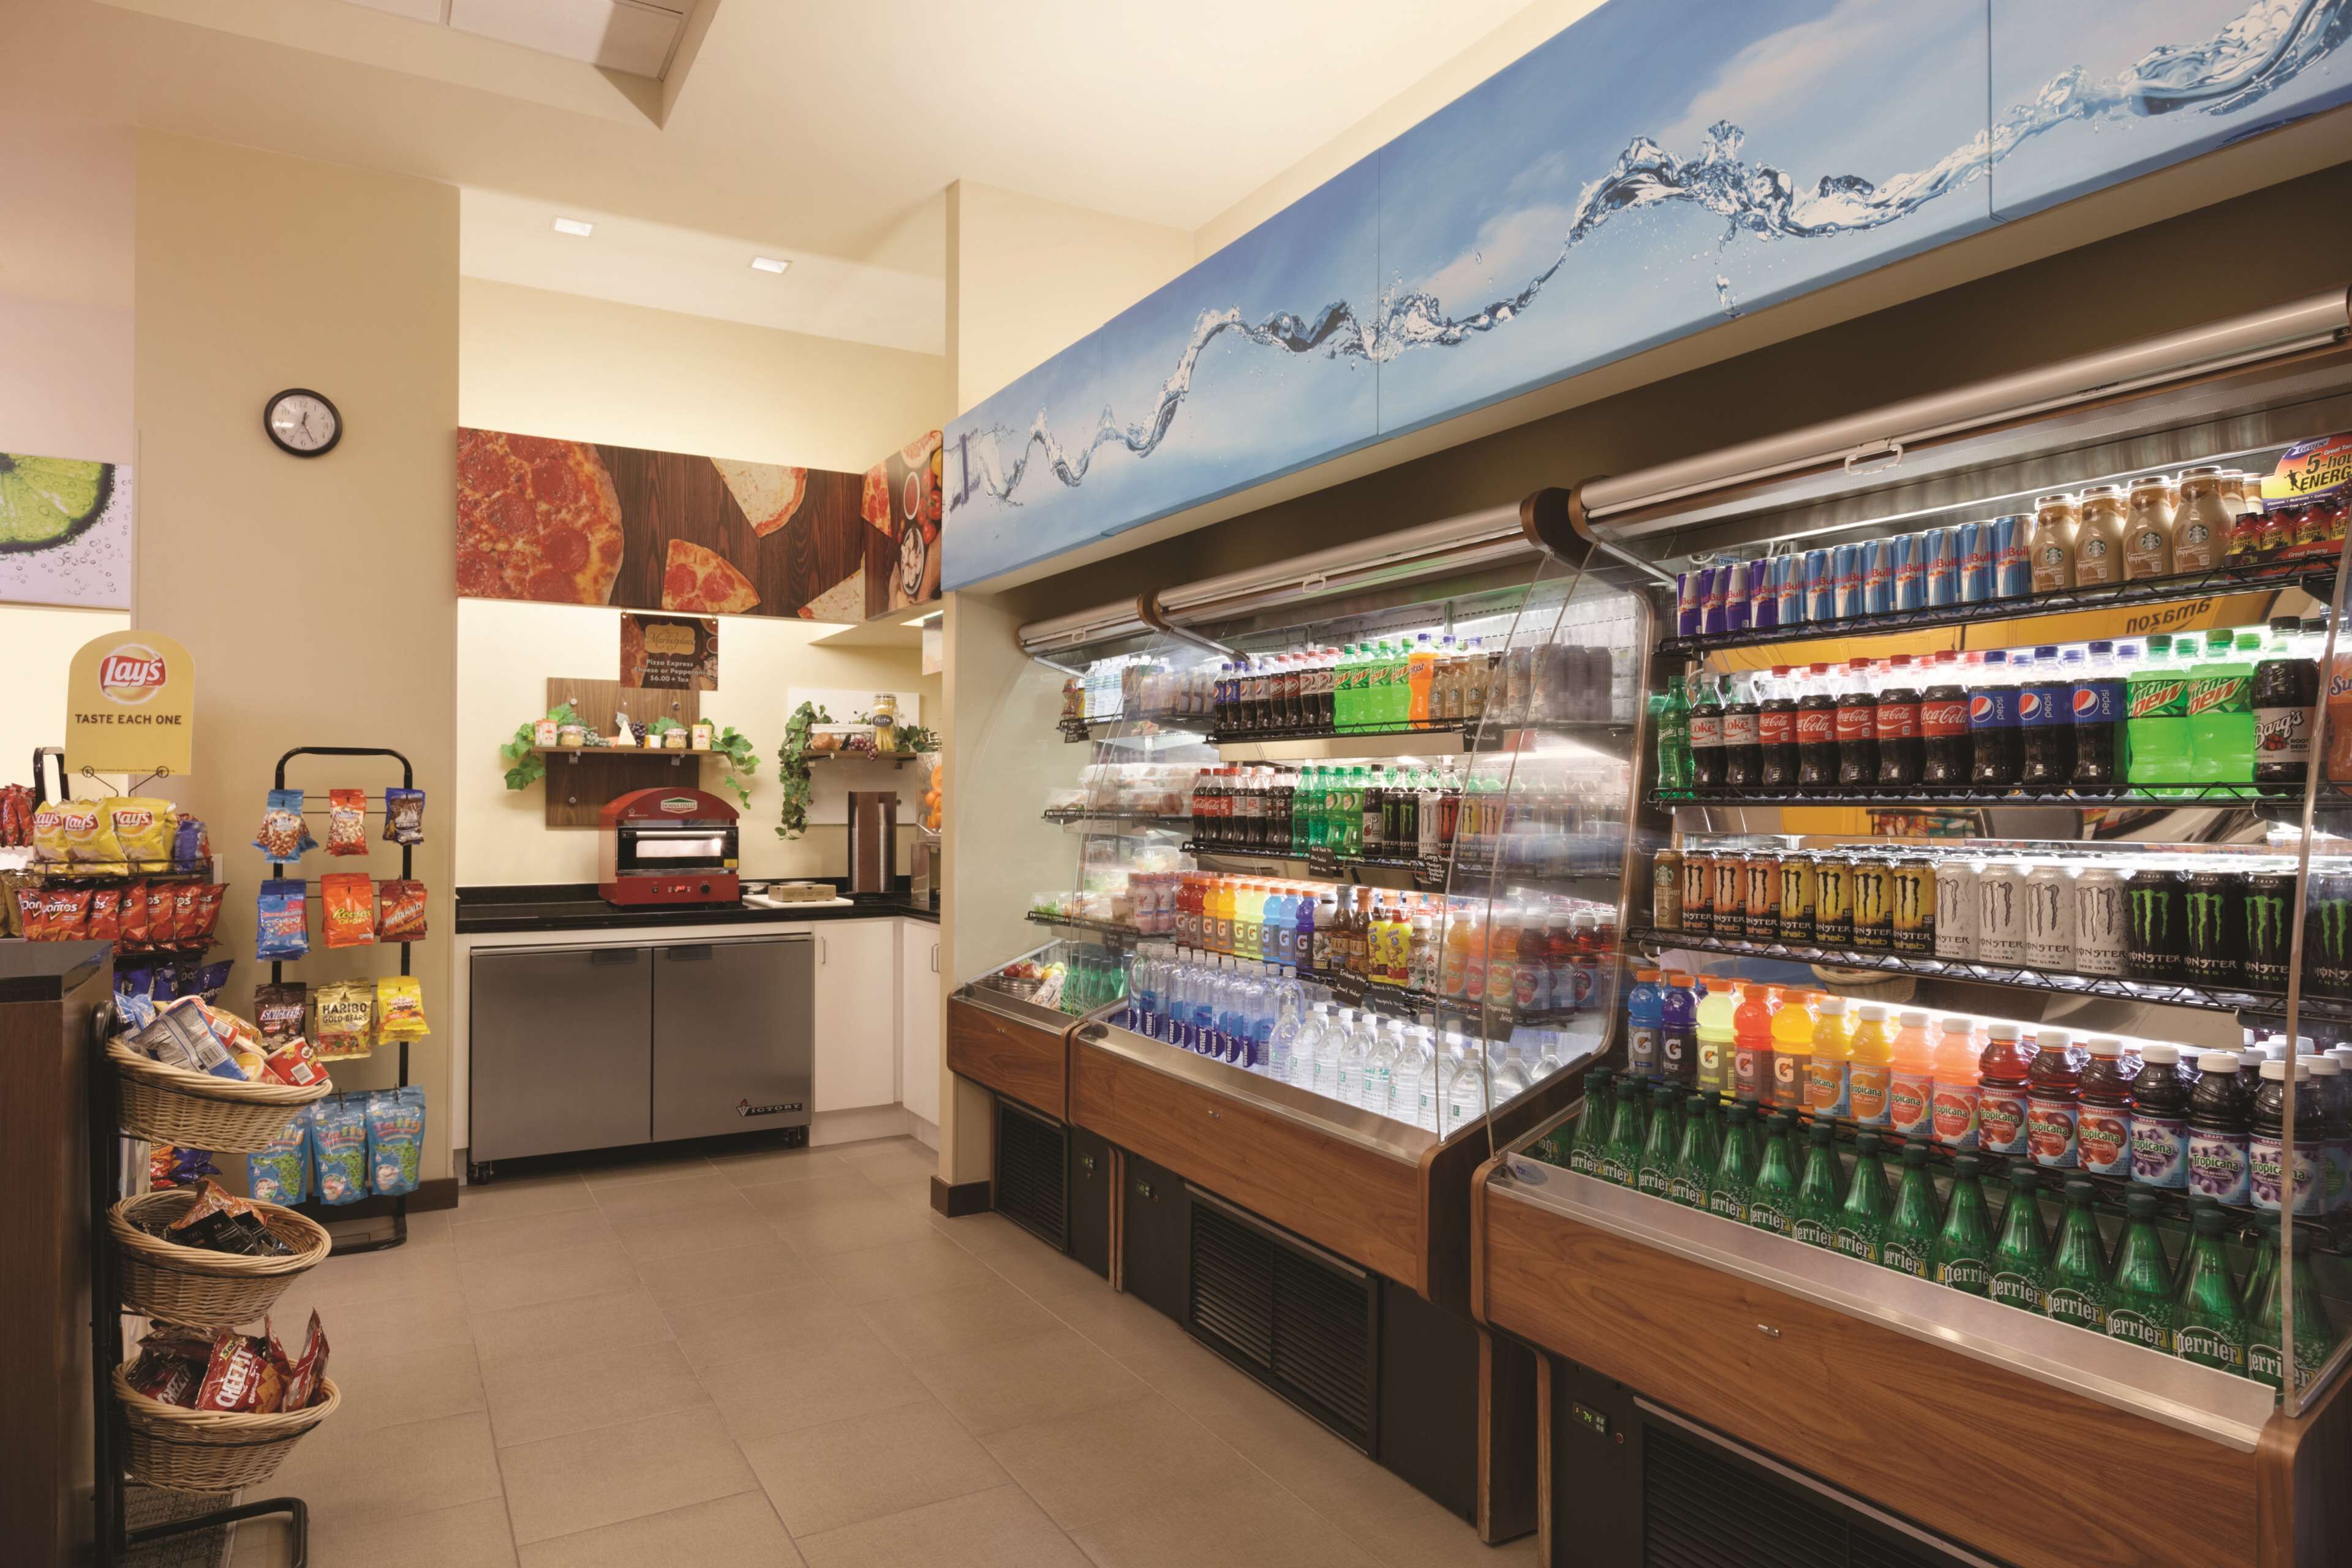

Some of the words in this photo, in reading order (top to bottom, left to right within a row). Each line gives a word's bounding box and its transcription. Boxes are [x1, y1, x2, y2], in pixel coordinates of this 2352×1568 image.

[2299, 441, 2328, 453] Grape
[2324, 447, 2341, 455] Great
[2300, 466, 2352, 491] ENERG
[102, 655, 165, 687] Lay's
[2101, 689, 2111, 715] pepsi
[75, 714, 113, 725] TASTE
[118, 714, 153, 725] EACH
[156, 715, 183, 726] ONE
[1838, 710, 1869, 724] Coca-Cola
[1877, 706, 1912, 720] Coca-Cola
[1921, 706, 1968, 725] Coca-Cola
[2255, 710, 2304, 750] Barq's
[66, 813, 95, 832] Lay's
[333, 908, 372, 919] Reese's
[1204, 919, 1212, 933] G
[1218, 921, 1226, 937] G
[1235, 923, 1243, 938] G
[1248, 925, 1257, 941] G
[1280, 930, 1289, 946] G
[1297, 935, 1308, 949] G
[262, 1008, 304, 1020] SNICKERS
[322, 1002, 368, 1015] HARIBO
[1486, 1003, 1512, 1014] Tropicana
[1145, 1012, 1154, 1036] smart
[1499, 1013, 1513, 1023] Juice
[1633, 1031, 1652, 1054] G
[1665, 1039, 1681, 1060] G
[1700, 1045, 1719, 1069] G
[1736, 1052, 1754, 1077] G
[1774, 1057, 1794, 1084] G
[737, 1104, 801, 1117] VICTORY
[2032, 1099, 2062, 1108] CRANBERRY
[2082, 1106, 2114, 1115] CRANBERRY
[1981, 1109, 2019, 1123] Tropicana
[376, 1120, 421, 1134] Taffy
[2029, 1120, 2068, 1136] Tropicana
[2079, 1126, 2120, 1143] Tropicana
[2132, 1137, 2172, 1155] Tropicana
[1571, 1155, 1599, 1174] errier
[2193, 1154, 2239, 1172] Tropicana
[1639, 1171, 1671, 1193] errier
[1673, 1183, 1703, 1206] errier
[1712, 1194, 1743, 1218] errier
[1752, 1207, 1786, 1231] errier
[1884, 1249, 1921, 1274] errier
